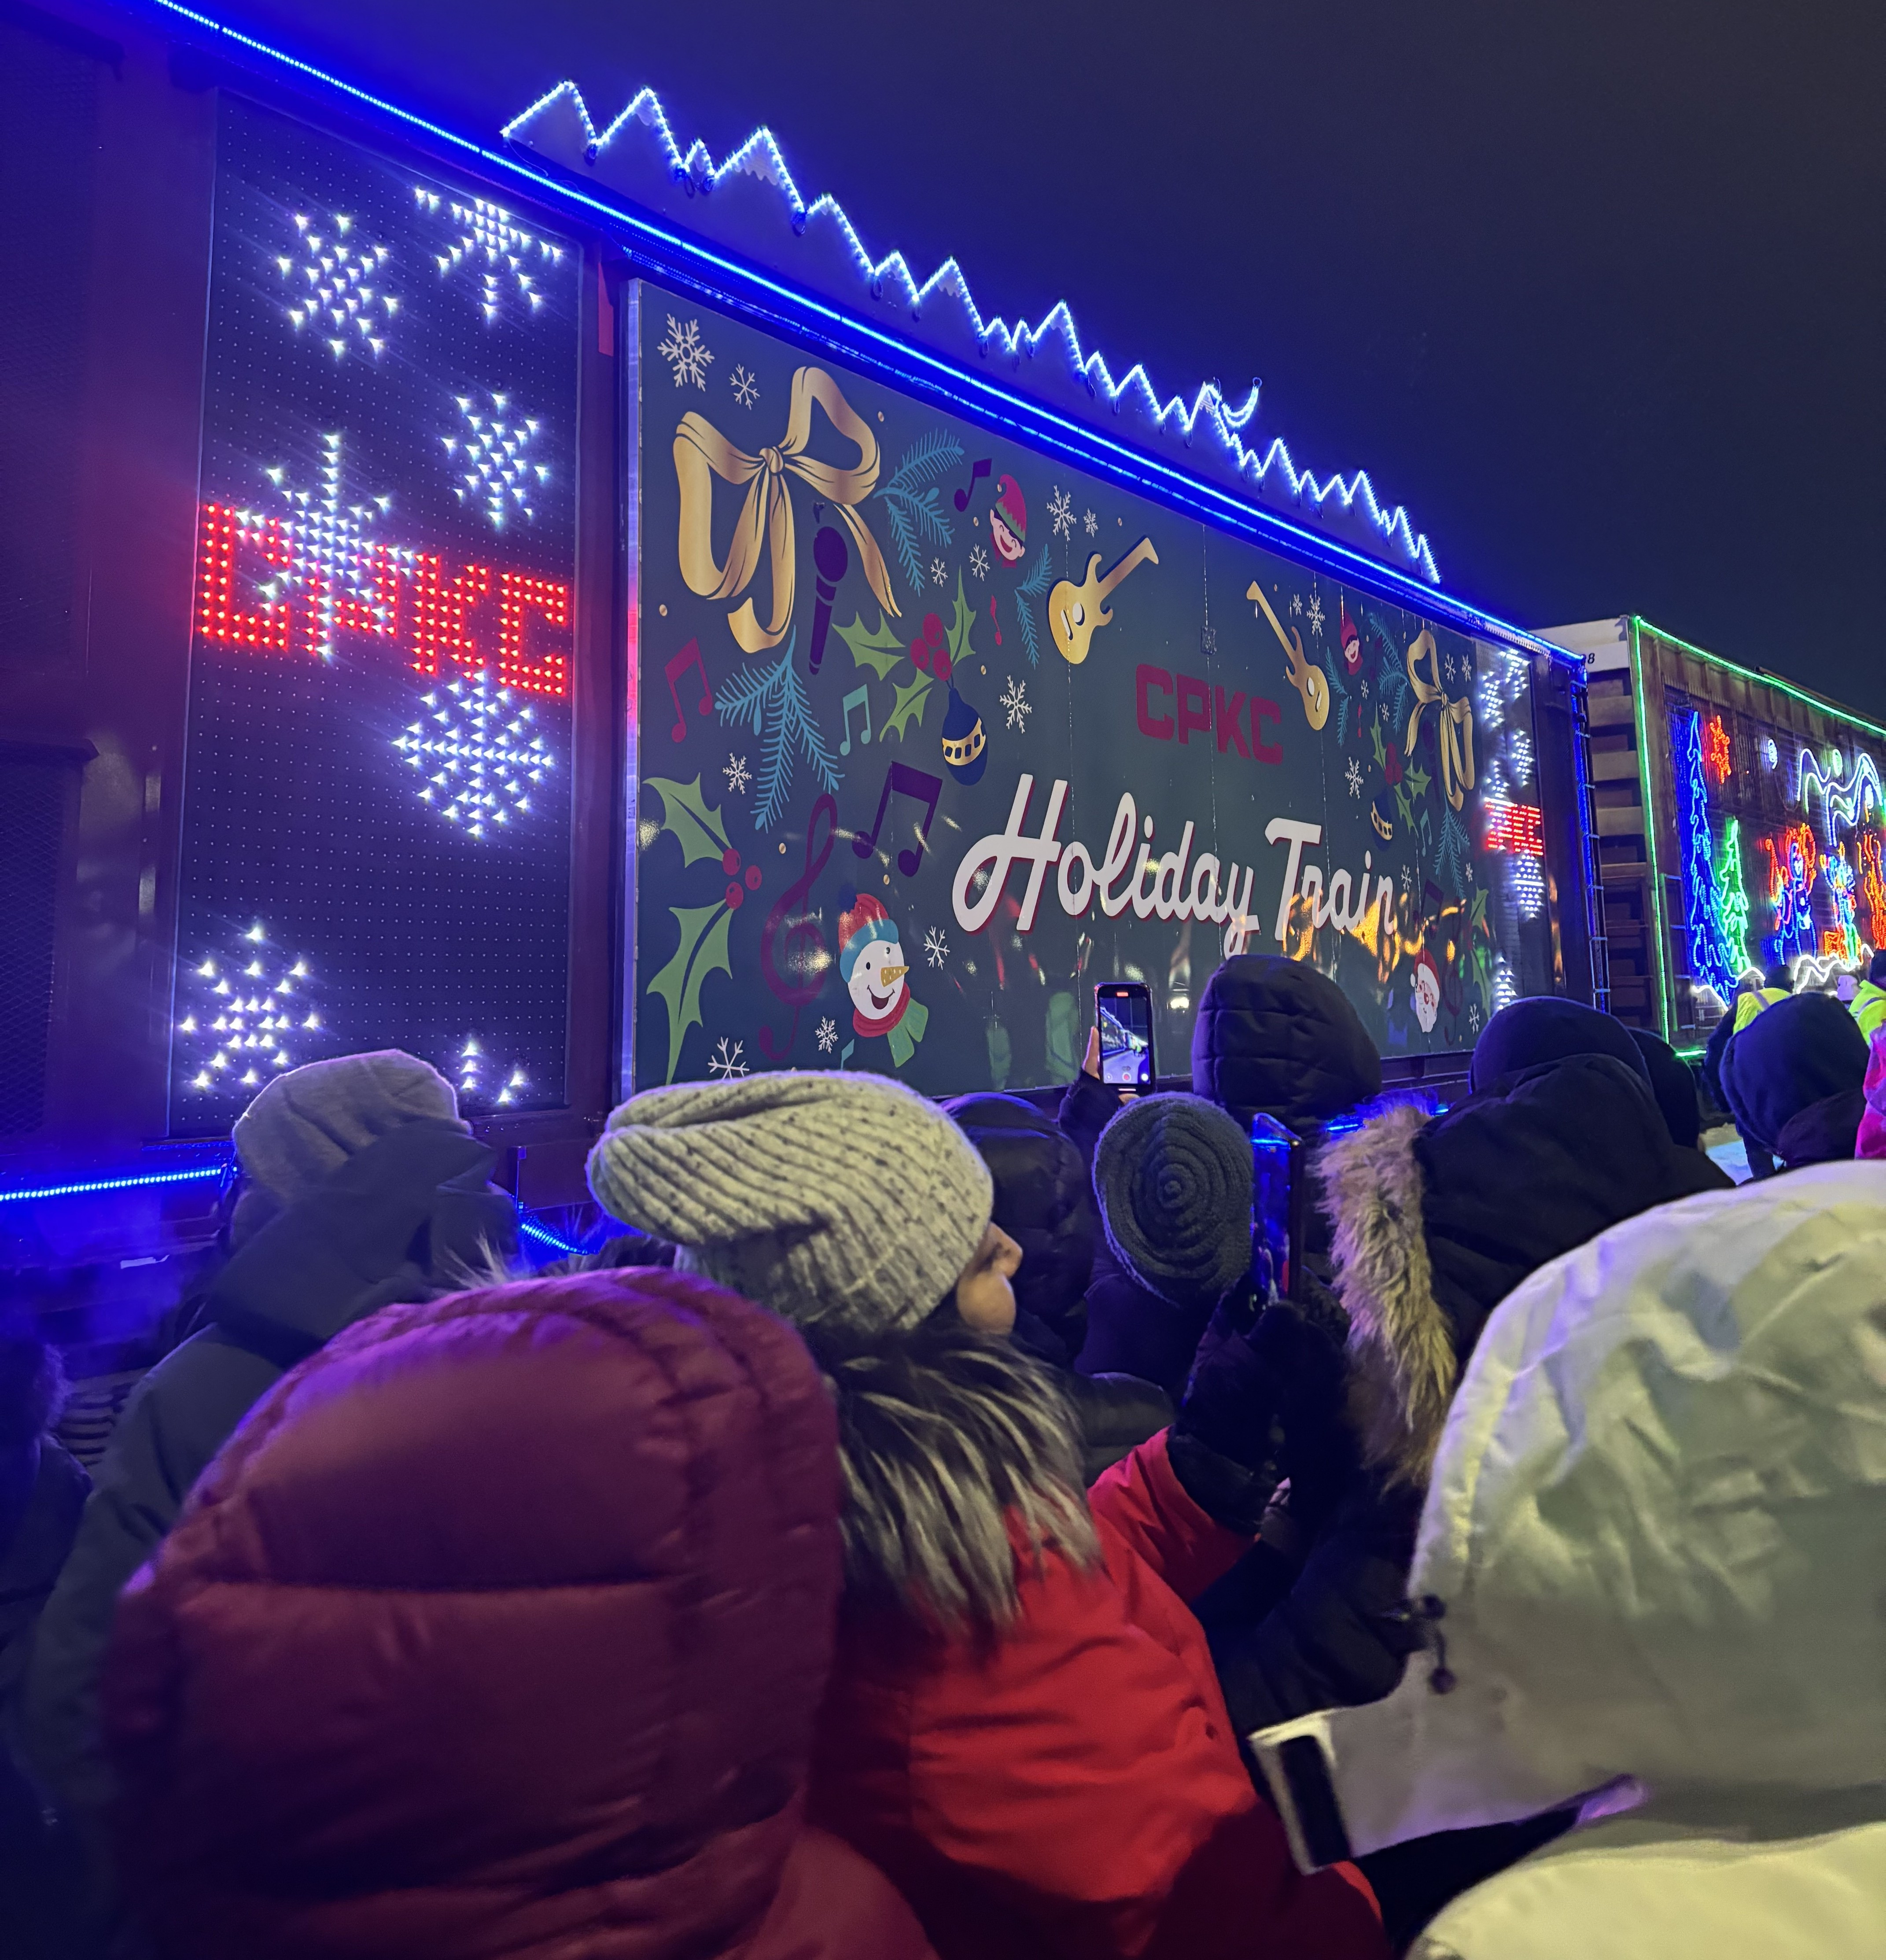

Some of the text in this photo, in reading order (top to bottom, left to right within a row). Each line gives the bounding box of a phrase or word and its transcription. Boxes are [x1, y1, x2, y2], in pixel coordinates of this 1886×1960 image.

[1136, 663, 1283, 765] CPKC
[952, 774, 1395, 958] Holiday Train
